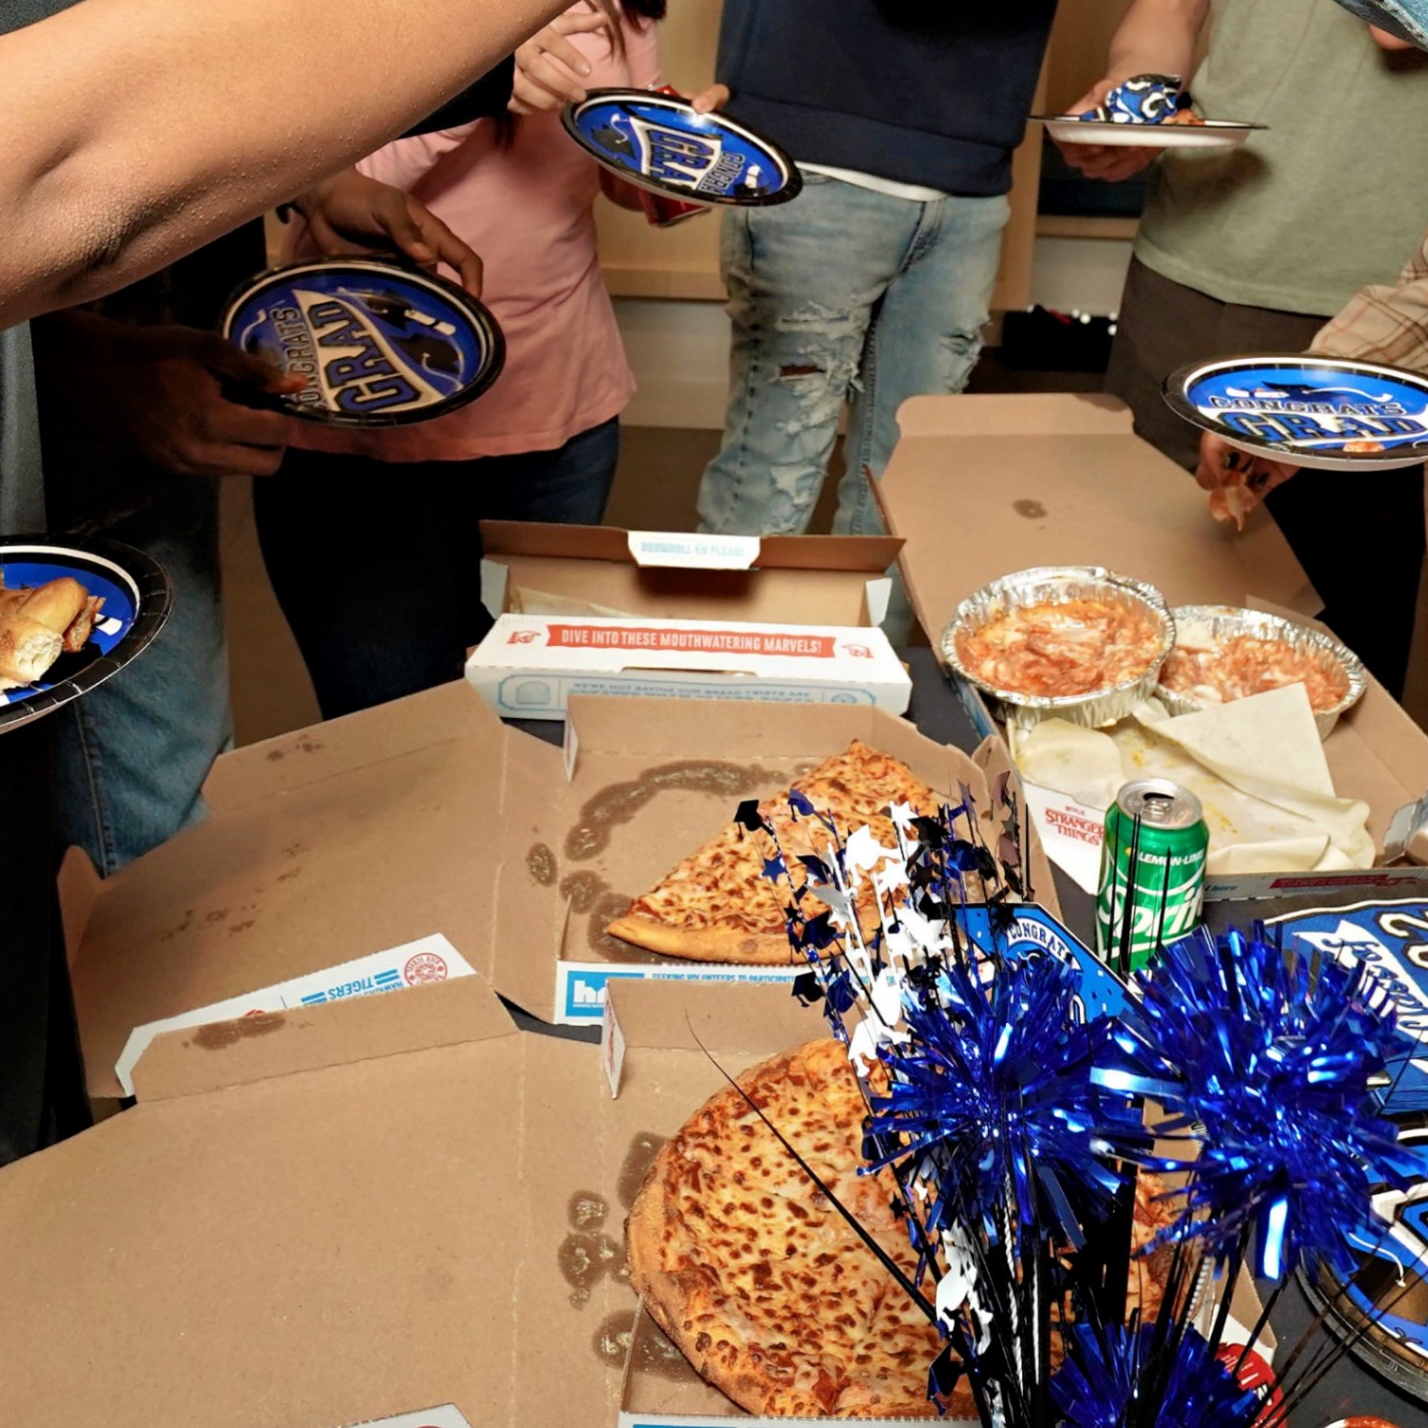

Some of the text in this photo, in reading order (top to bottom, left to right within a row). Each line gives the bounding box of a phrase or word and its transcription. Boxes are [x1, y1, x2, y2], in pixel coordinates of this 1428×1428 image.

[306, 300, 423, 412] GRAD
[1209, 394, 1405, 416] CONGRATS
[1217, 412, 1428, 442] GRAD
[561, 629, 821, 654] DIVE INTO THESE MOUTHWATERING MARVELS!
[1058, 824, 1099, 846] THINGS
[1008, 922, 1067, 957] CONGRAT
[328, 976, 373, 1000] TIGERS
